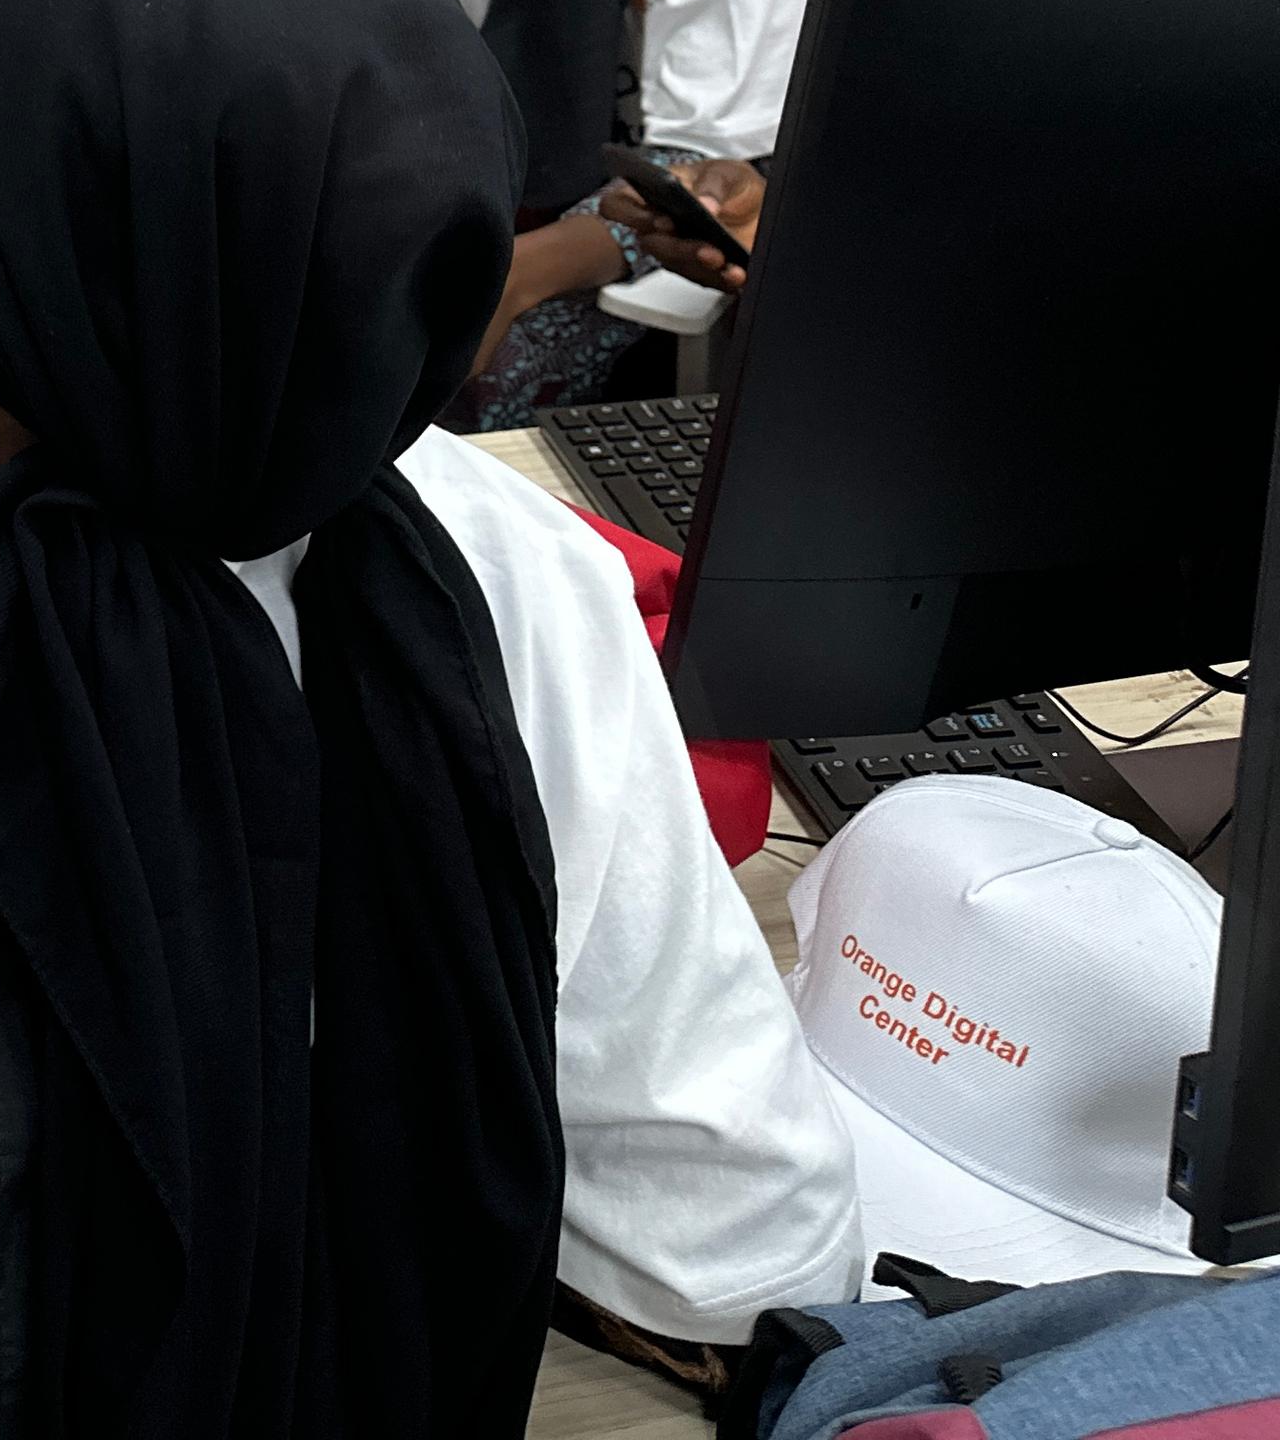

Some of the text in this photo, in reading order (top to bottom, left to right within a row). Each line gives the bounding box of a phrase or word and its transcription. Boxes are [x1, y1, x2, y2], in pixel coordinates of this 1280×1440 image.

[841, 934, 1030, 1068] Orange Digital
[859, 995, 950, 1065] Center
